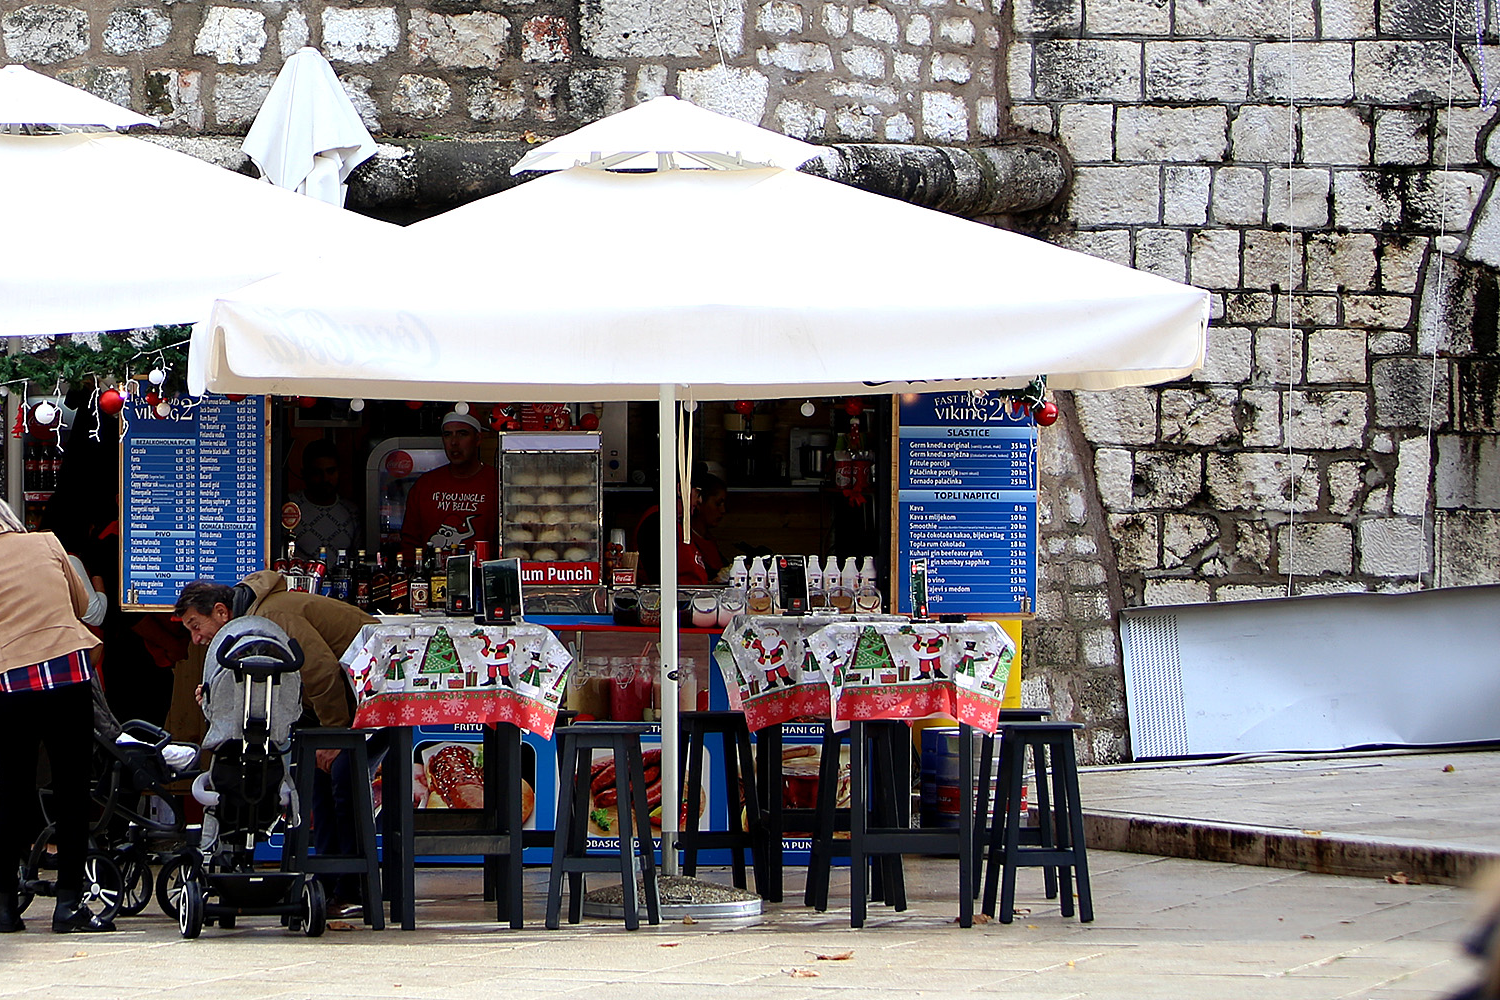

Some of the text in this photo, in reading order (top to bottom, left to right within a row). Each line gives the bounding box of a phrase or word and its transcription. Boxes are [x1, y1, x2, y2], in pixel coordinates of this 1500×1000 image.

[934, 395, 959, 406] FAST
[947, 428, 990, 437] SLASTICE
[947, 442, 970, 450] original
[947, 451, 970, 459] snježna
[930, 460, 950, 468] porcija
[938, 469, 958, 477] porcija
[934, 478, 962, 487] palačinka
[432, 491, 486, 502] IF YOU JINGLE
[934, 491, 1000, 500] TOPLI NAPITCI
[437, 501, 478, 511] MY BELLS
[928, 514, 956, 523] mlijekom
[910, 532, 926, 541] Topla
[910, 541, 926, 550] Topla
[930, 550, 940, 559] gin
[970, 550, 983, 559] pink
[930, 559, 990, 568] gin bombay sapphire
[522, 565, 592, 581] um Punch
[454, 723, 483, 731] FRITU
[782, 725, 807, 734] HANI
[586, 839, 620, 848] OBASIC
[792, 841, 812, 850] PUN
